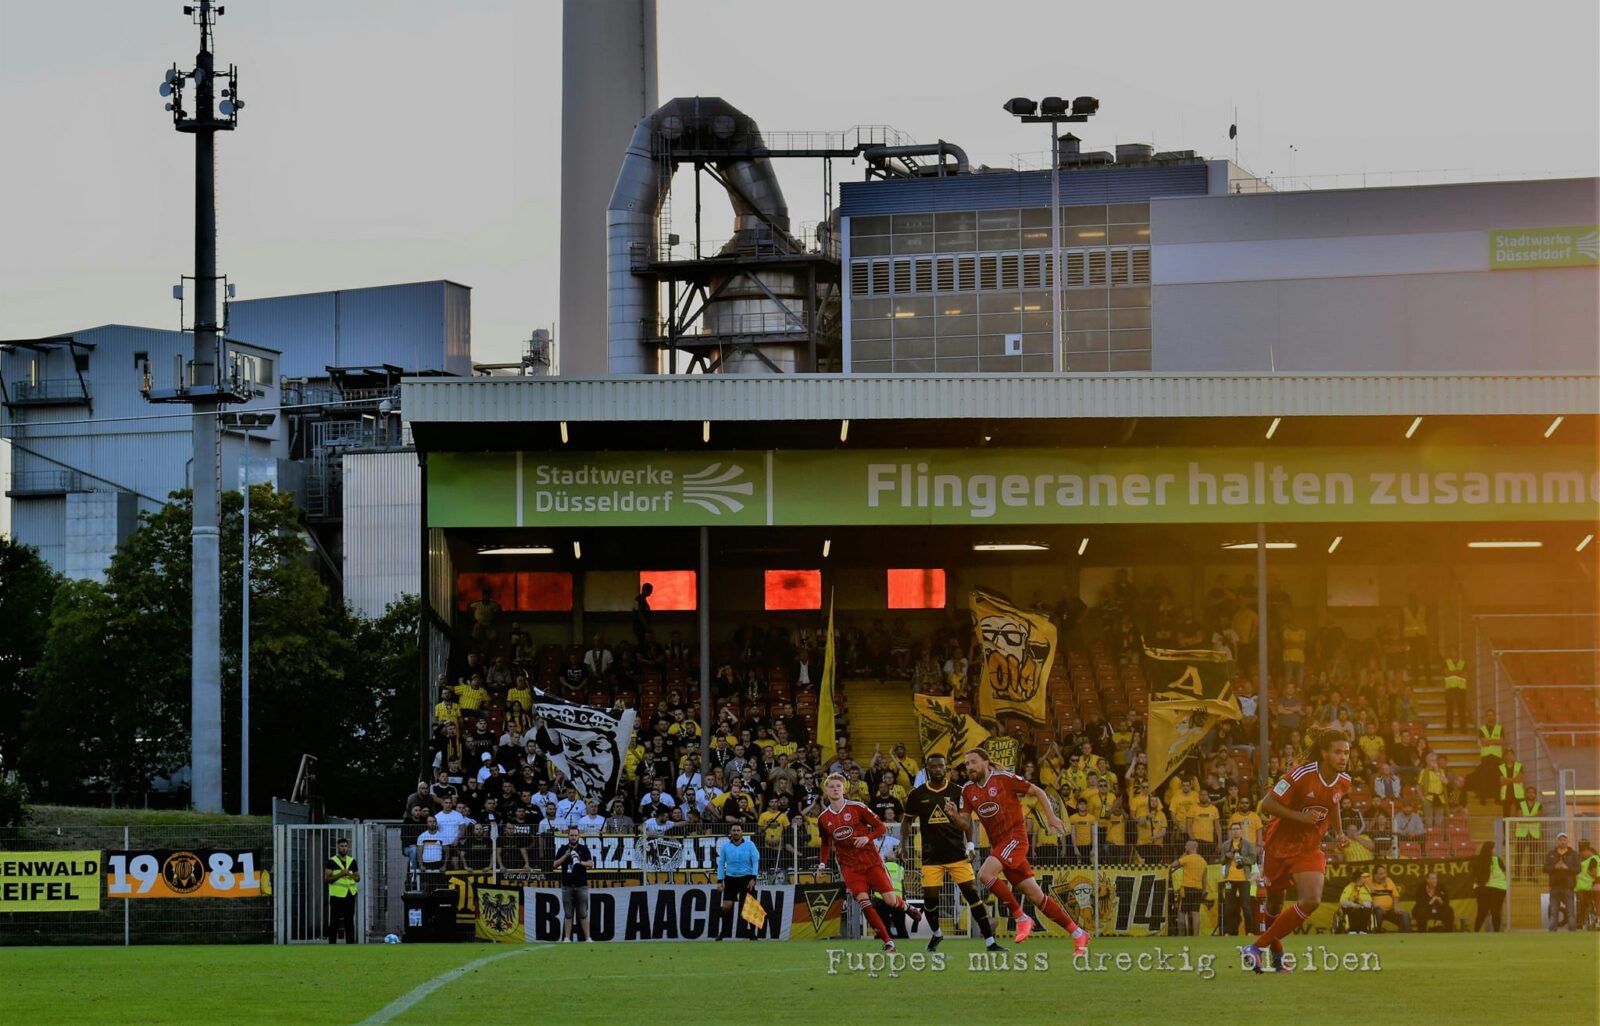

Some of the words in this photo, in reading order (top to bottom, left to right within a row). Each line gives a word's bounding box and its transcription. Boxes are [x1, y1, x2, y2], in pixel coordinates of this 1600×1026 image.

[1496, 234, 1571, 248] Stadtwerke
[1496, 247, 1571, 262] Düsseldorf
[536, 464, 673, 485] Stadtwerke
[867, 463, 1175, 518] Flingeraner
[1189, 462, 1354, 505] halten
[536, 490, 673, 513] Düsseldorf
[0, 861, 98, 876] ENWALD
[0, 882, 79, 901] EIFEL
[812, 892, 829, 905] A
